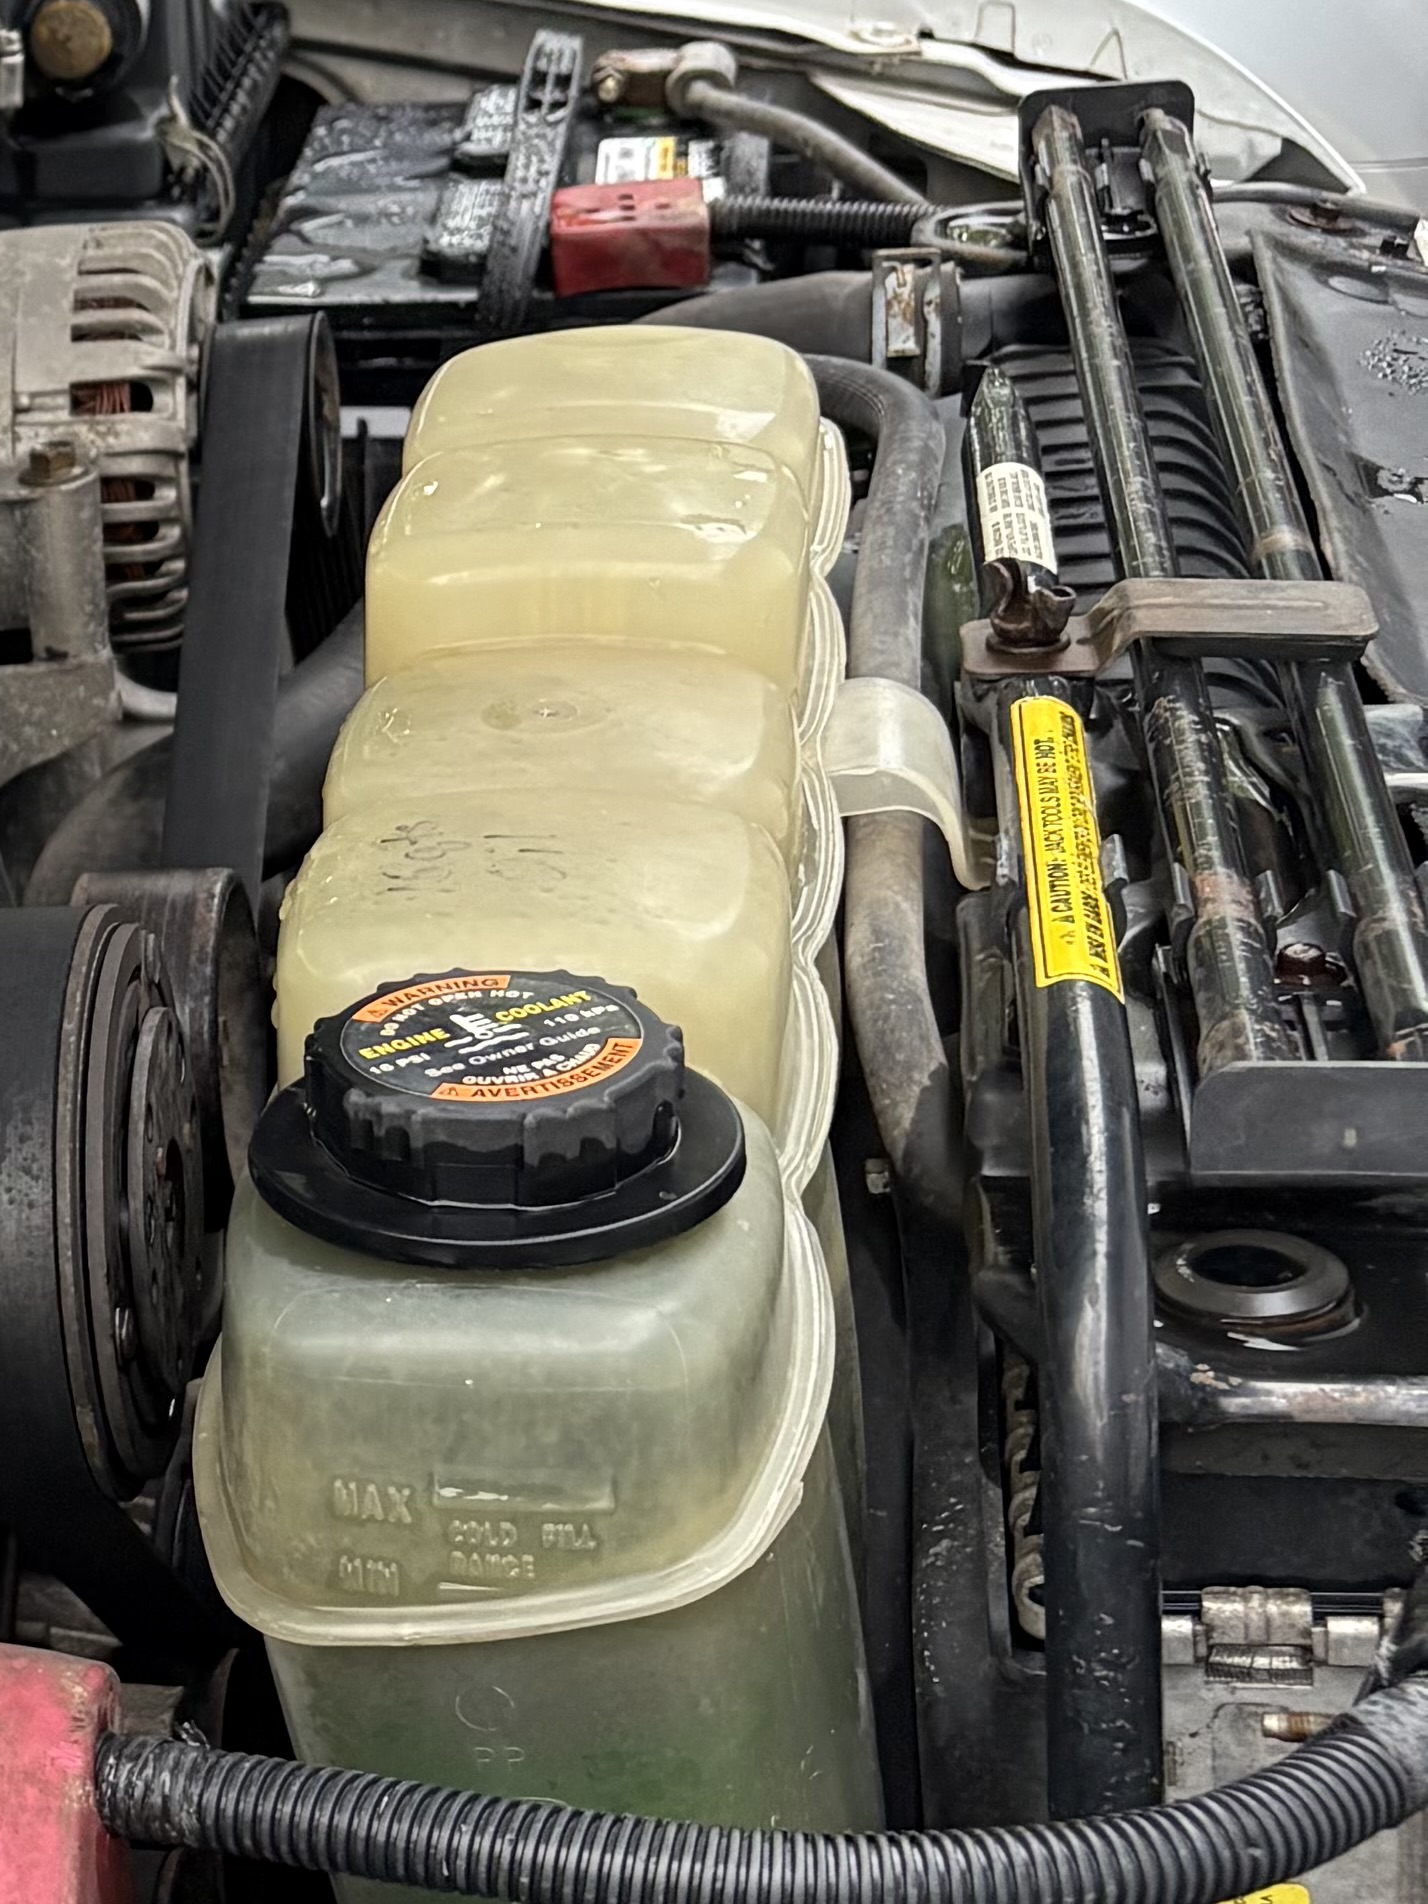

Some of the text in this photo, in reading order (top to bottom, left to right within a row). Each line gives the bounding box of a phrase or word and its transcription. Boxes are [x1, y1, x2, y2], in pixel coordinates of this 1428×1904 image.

[1038, 775, 1059, 800] MAY
[1042, 798, 1064, 828] TOOLS
[1044, 828, 1065, 854] JACK
[386, 976, 500, 1007] WARNING
[398, 1003, 425, 1024] NOT
[428, 989, 483, 1006] OPEN
[490, 989, 534, 1000] HOT
[358, 990, 593, 1060] ENGINE COOLANT
[581, 1004, 621, 1019] kPa
[396, 1052, 432, 1068] PSI
[424, 1025, 602, 1077] See Owner Guide
[461, 1072, 540, 1085] OUVRIR
[470, 1041, 634, 1098] AVERTISSEMENT
[332, 1477, 413, 1524] MAX
